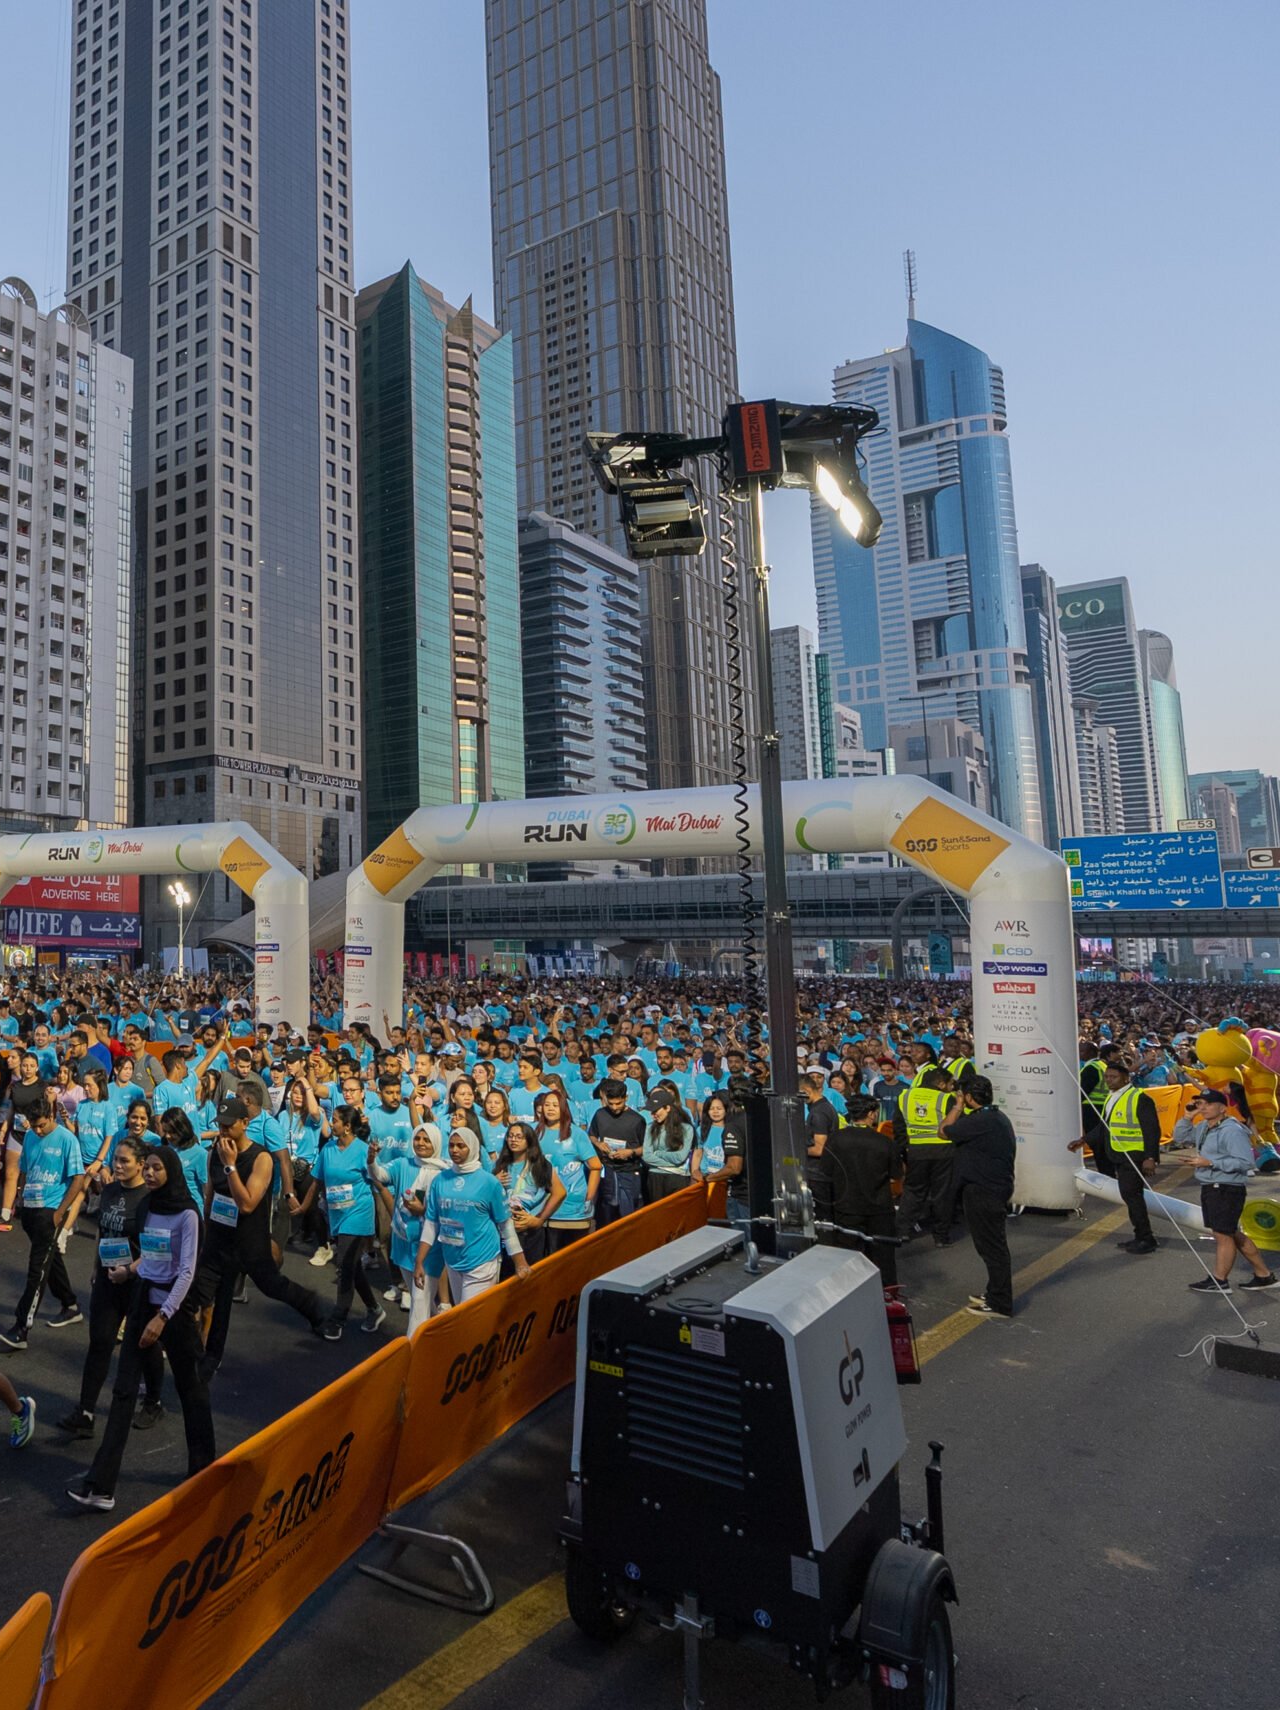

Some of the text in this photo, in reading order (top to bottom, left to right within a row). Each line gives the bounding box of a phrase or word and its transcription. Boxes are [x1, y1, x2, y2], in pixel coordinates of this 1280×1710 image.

[747, 406, 764, 468] GENERAC
[218, 757, 229, 767] THE
[231, 759, 252, 771] TOWER
[253, 762, 270, 774] PLAZA
[547, 810, 591, 823] DUBAI
[645, 812, 722, 833] Mai Dubai
[1197, 820, 1213, 828] 53
[524, 823, 588, 844] RUN
[1187, 833, 1215, 844] شارع
[941, 835, 991, 844] Sun&Sand
[1159, 835, 1182, 846] قصر
[107, 840, 144, 855] Mai Dubai
[941, 843, 970, 852] Sports
[1188, 846, 1216, 856] شارع
[48, 848, 80, 861] RUN
[1101, 850, 1135, 860] ديسمبر
[1123, 859, 1153, 867] Palace
[1155, 858, 1166, 866] St
[1102, 867, 1145, 875] December
[1086, 875, 1219, 887] شارع الشيخ خليفة بن زايد
[41, 888, 120, 902] ADVERTISE HERE
[1086, 889, 1115, 897] Sheikh
[1116, 888, 1147, 896] Khalifa
[1165, 887, 1192, 896] Zayed
[1193, 886, 1205, 894] St
[89, 917, 138, 937] لايف
[994, 920, 1029, 932] AWR
[1006, 947, 1033, 956] CBD
[996, 984, 1032, 992] talabat
[993, 1024, 1034, 1033] WHOOP
[1021, 1065, 1050, 1075] wasl
[845, 1403, 872, 1439] GLOW POWER
